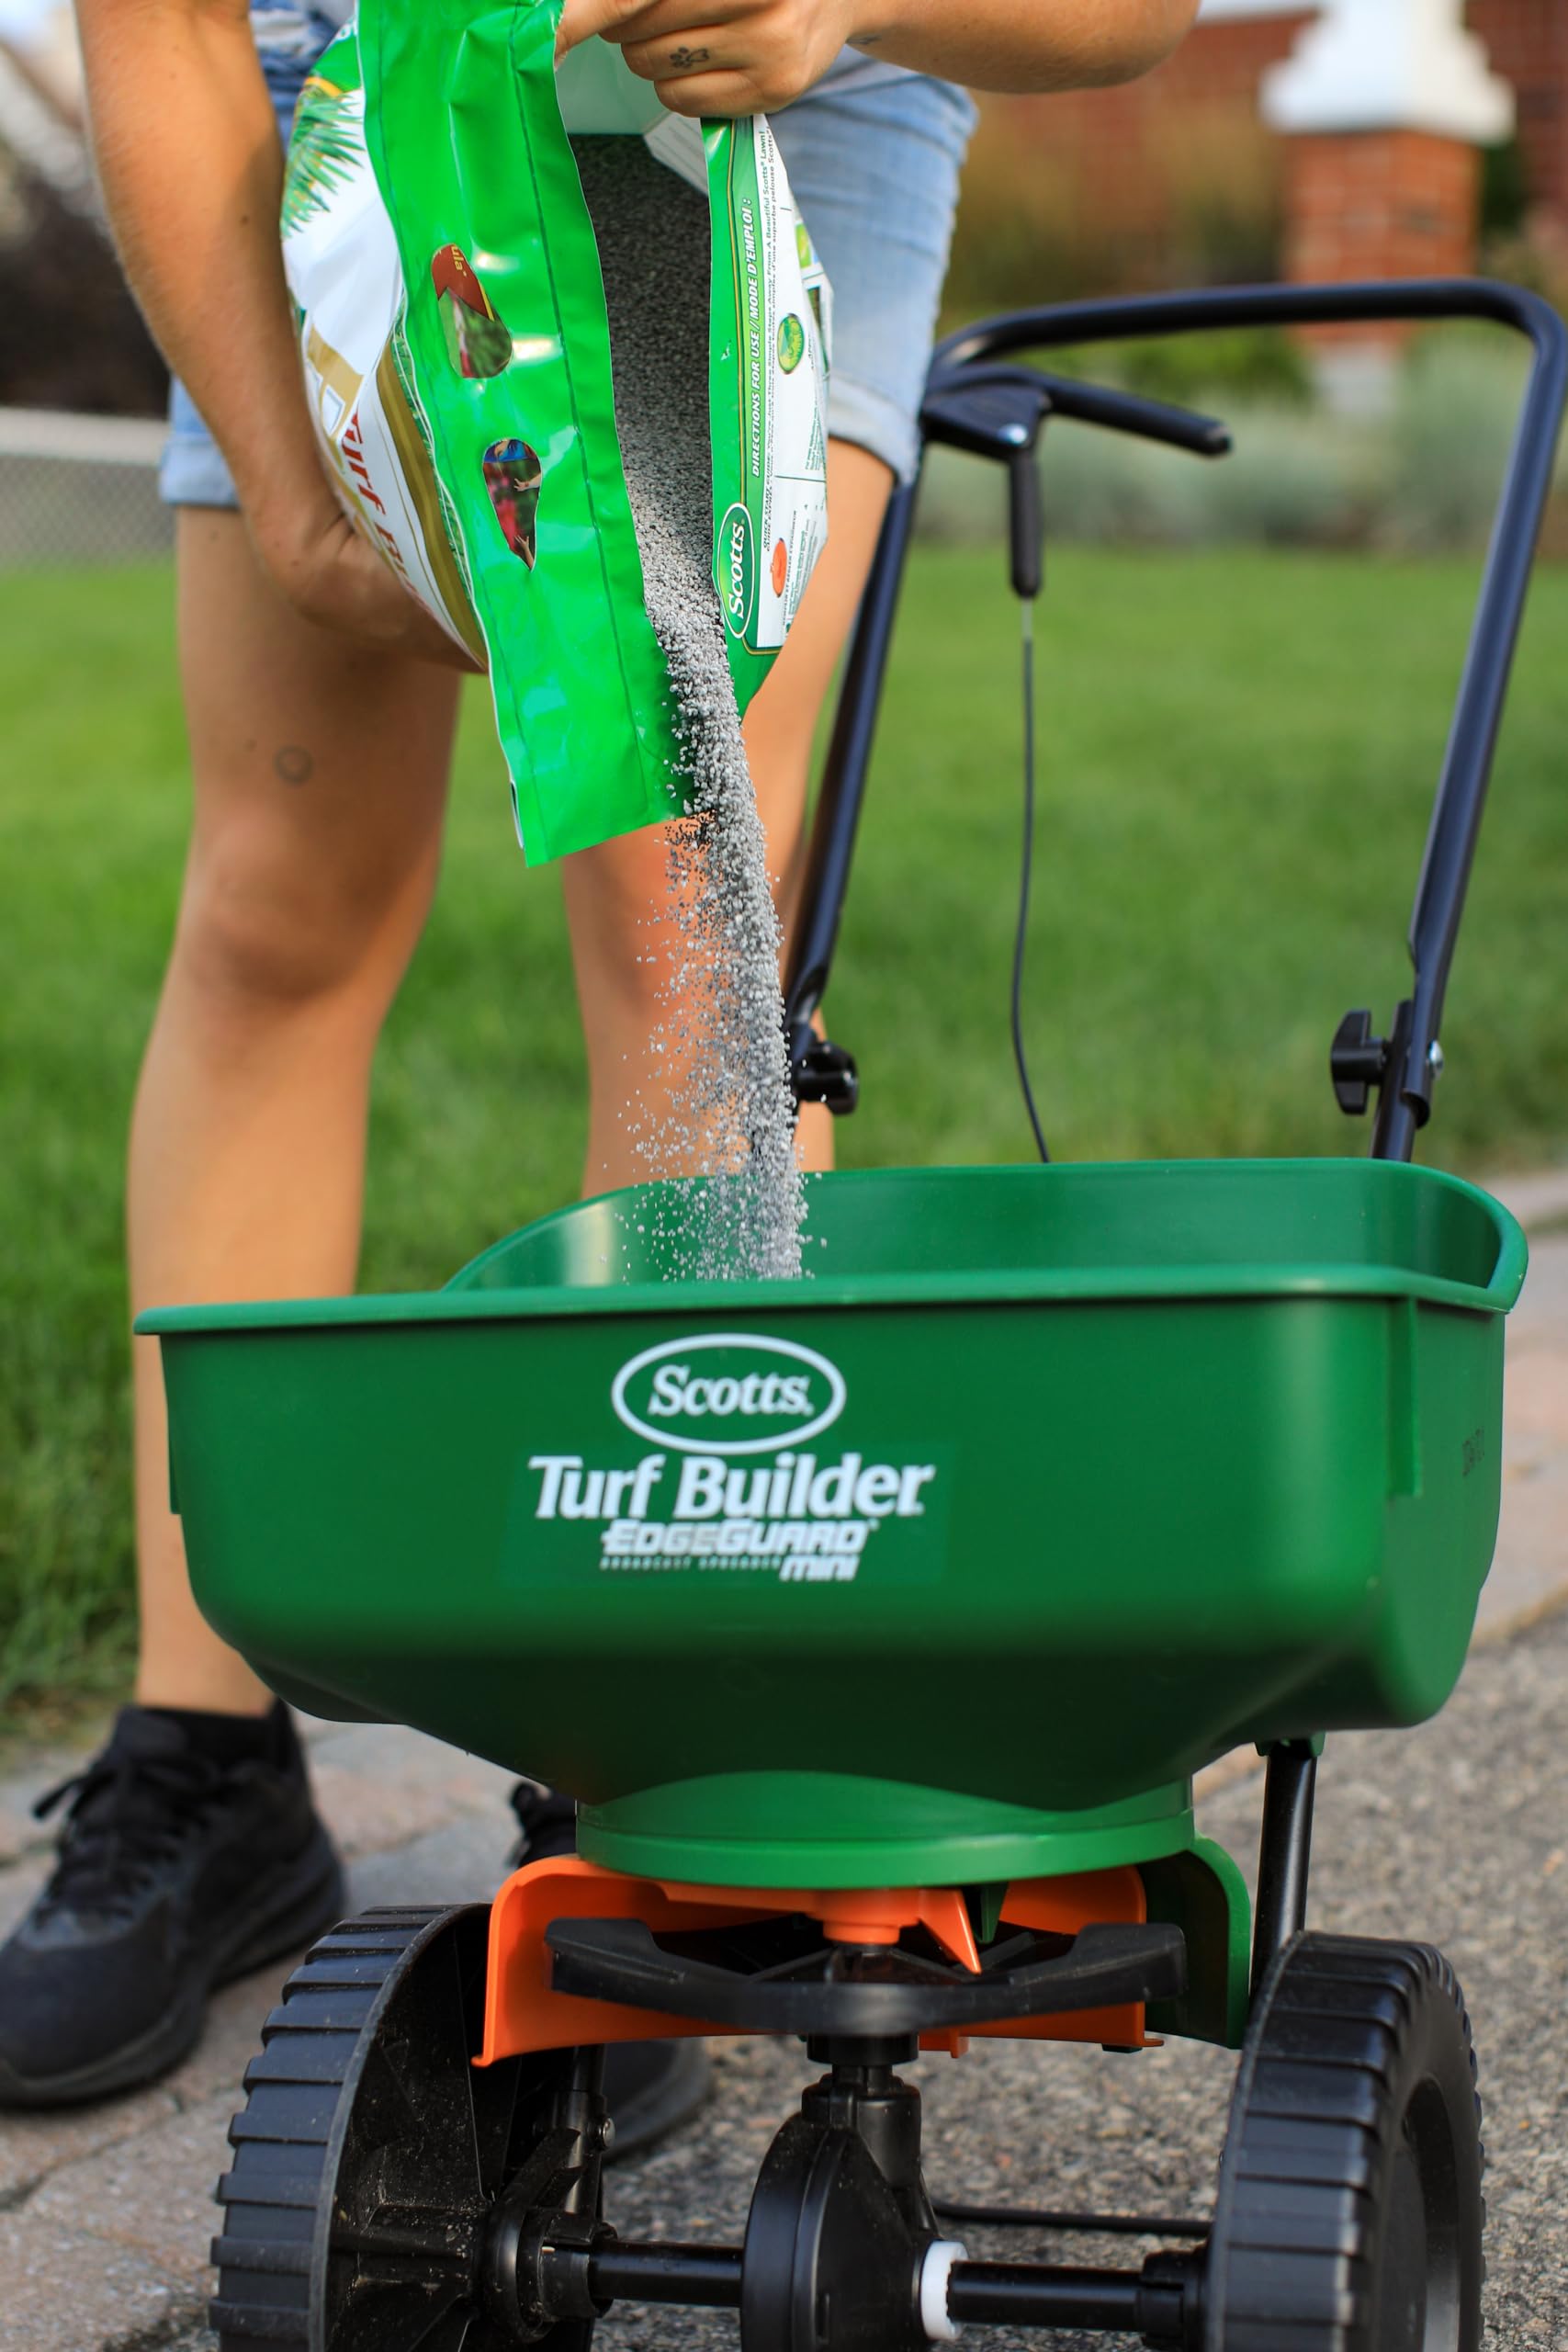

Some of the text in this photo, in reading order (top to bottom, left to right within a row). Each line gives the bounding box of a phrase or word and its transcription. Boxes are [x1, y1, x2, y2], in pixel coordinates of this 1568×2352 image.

[742, 207, 757, 275] D'EMPLOI
[748, 277, 759, 320] MODE
[750, 331, 760, 358] USE
[751, 362, 760, 390] FOR
[751, 393, 761, 477] DIRECTIONS
[728, 521, 745, 619] Scotts
[648, 1364, 812, 1416] Scotts
[527, 1452, 936, 1519] Turf Builder
